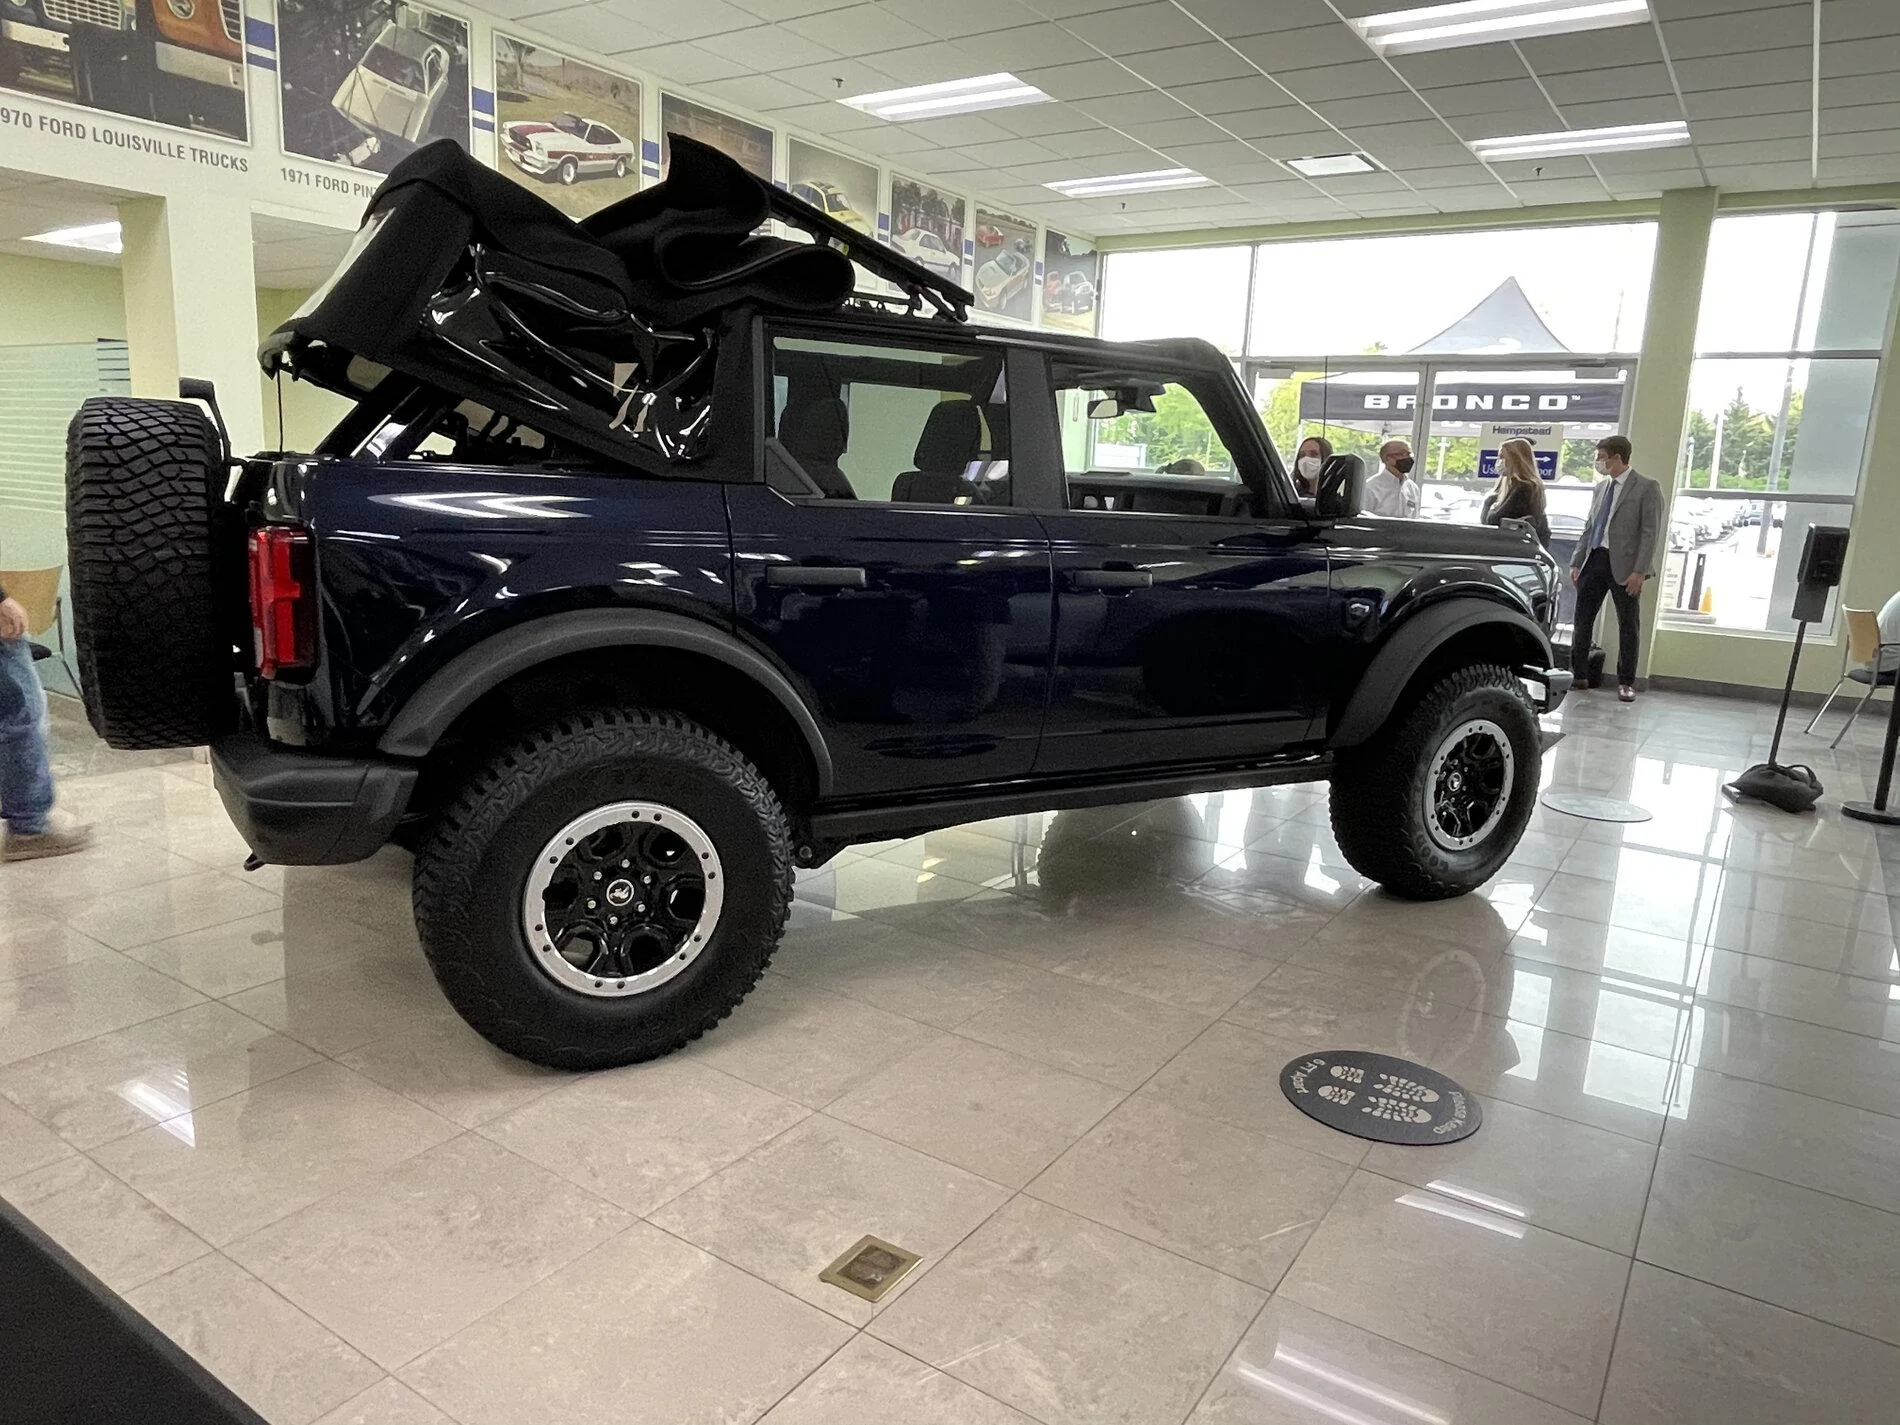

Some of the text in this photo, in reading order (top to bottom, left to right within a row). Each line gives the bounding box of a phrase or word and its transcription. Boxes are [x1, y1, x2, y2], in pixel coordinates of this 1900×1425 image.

[0, 107, 248, 172] 970 FORD LOUISVILLE TRUCKS
[281, 168, 376, 198] 1971 FORD PIN
[1364, 394, 1568, 410] BRONCO
[1492, 425, 1552, 437] Hempstead
[1312, 1058, 1326, 1066] 6
